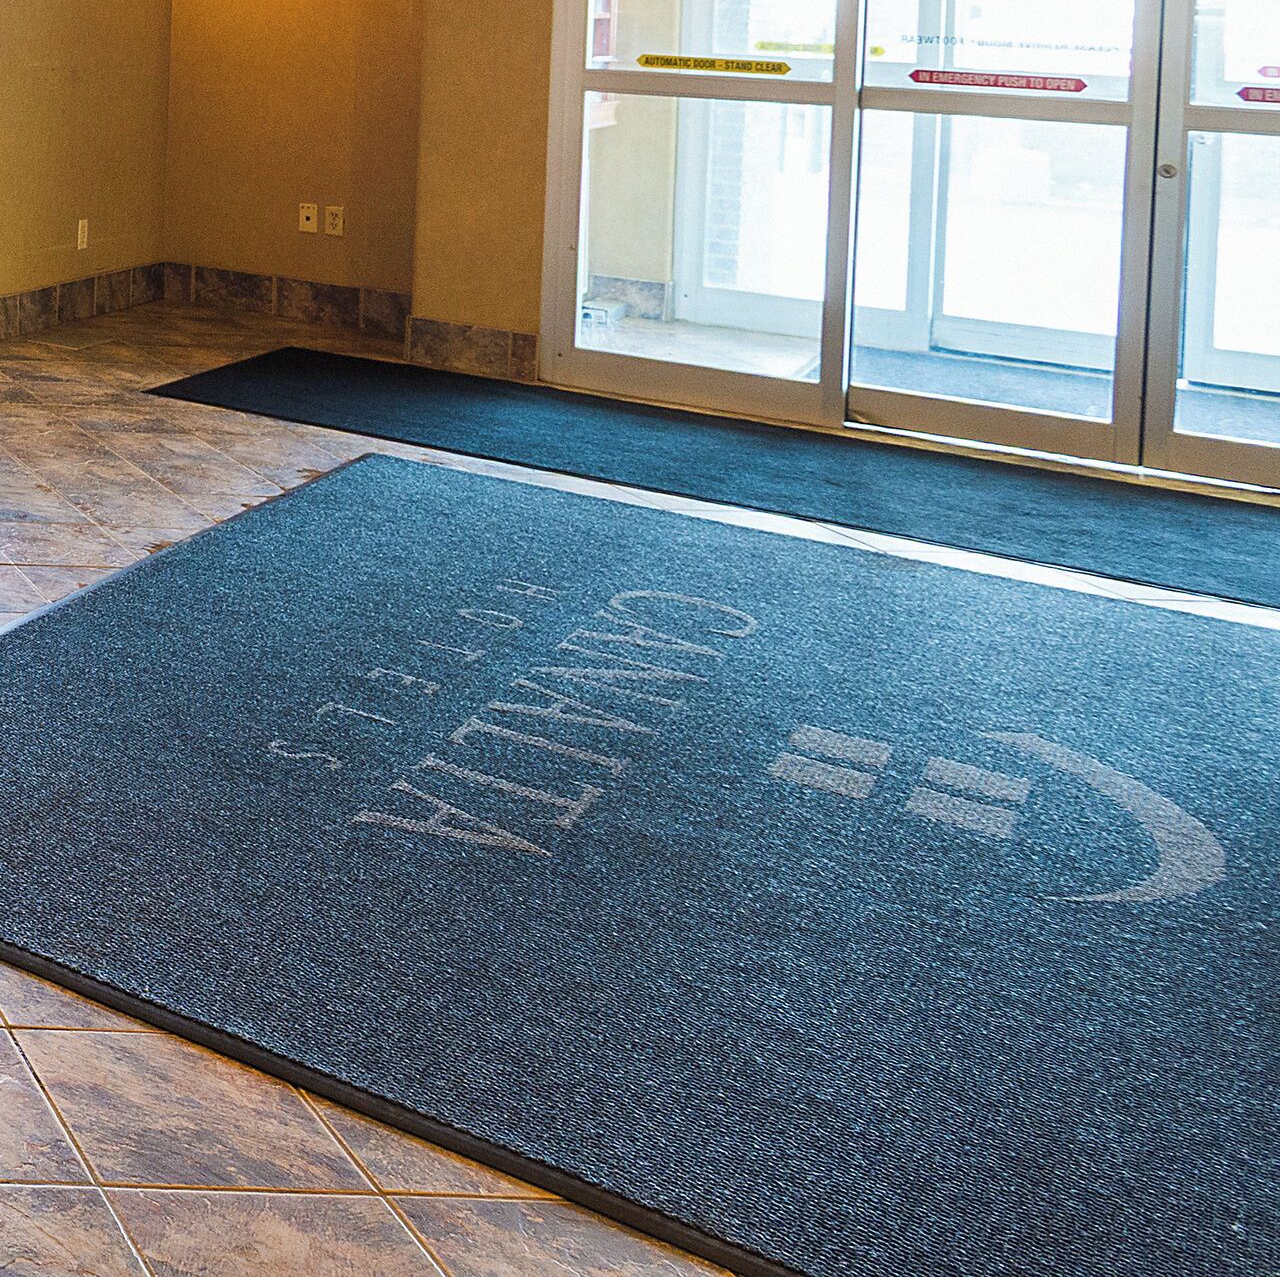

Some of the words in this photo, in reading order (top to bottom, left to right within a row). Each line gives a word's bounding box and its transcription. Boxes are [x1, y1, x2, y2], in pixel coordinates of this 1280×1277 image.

[644, 56, 691, 68] AUTOMATIC
[693, 58, 716, 69] DOOR
[724, 60, 752, 72] STAND
[754, 63, 783, 73] CLEAR
[918, 72, 930, 82] IN
[932, 72, 994, 86] EMERGENCY
[997, 75, 1025, 87] PUSH
[1030, 78, 1043, 89] TO
[1046, 79, 1075, 91] OPEN
[268, 578, 563, 771] HOTELS
[352, 589, 758, 858] CANALTA
